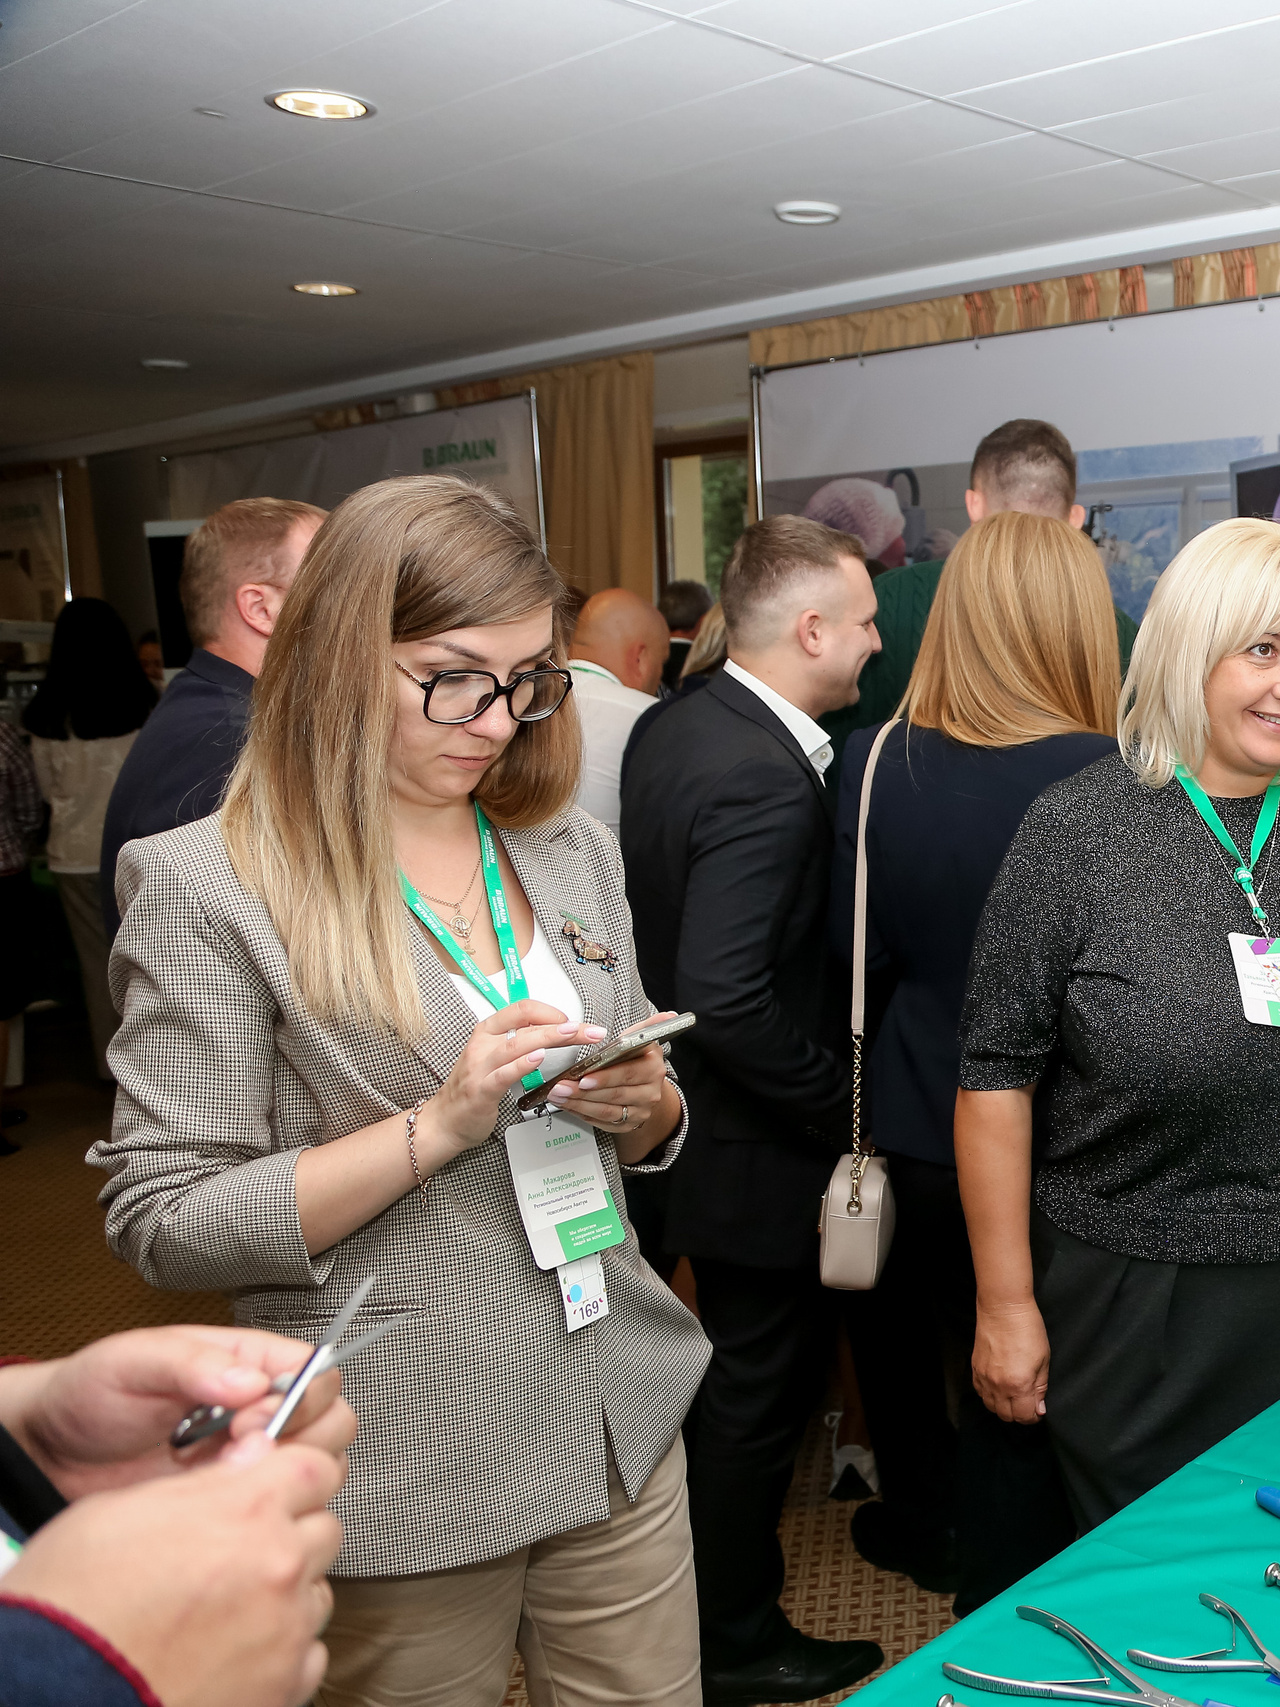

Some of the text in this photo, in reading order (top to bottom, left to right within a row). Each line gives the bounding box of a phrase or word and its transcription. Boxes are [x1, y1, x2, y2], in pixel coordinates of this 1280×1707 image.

[437, 438, 497, 465] BRAUN
[488, 836, 496, 864] BRAUN
[414, 903, 438, 931] BRAUN
[497, 896, 508, 924] BRAUN
[460, 960, 485, 988] BRAUN
[510, 954, 522, 980] BRAUN
[553, 1132, 581, 1146] BRAUN
[527, 1175, 595, 1201] Анна Александровна
[543, 1172, 575, 1186] Макарова
[533, 1187, 594, 1209] Региональный представитель
[546, 1204, 573, 1216] Новосибирск
[579, 1300, 599, 1320] 169
